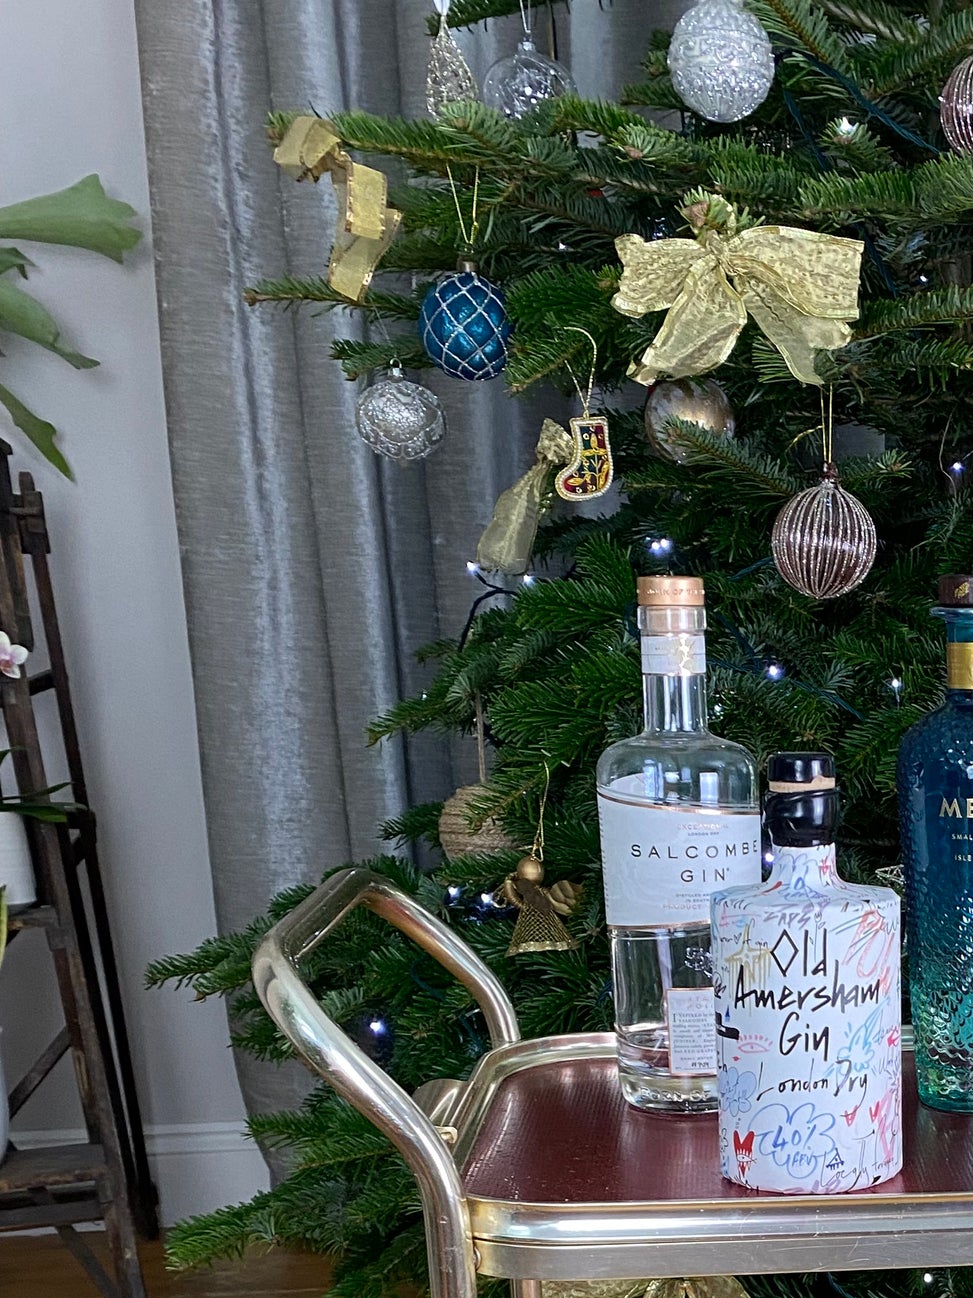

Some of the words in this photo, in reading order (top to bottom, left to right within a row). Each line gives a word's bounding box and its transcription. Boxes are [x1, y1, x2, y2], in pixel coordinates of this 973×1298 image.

[630, 839, 758, 859] SALCOMBE
[954, 854, 972, 862] ISLE
[680, 868, 726, 883] GIN
[769, 928, 828, 978] Old
[733, 959, 881, 1014] Amersham
[778, 1011, 830, 1062] Gin
[756, 1058, 829, 1101] London
[833, 1059, 868, 1118] Dry
[771, 1124, 817, 1150] 40%
